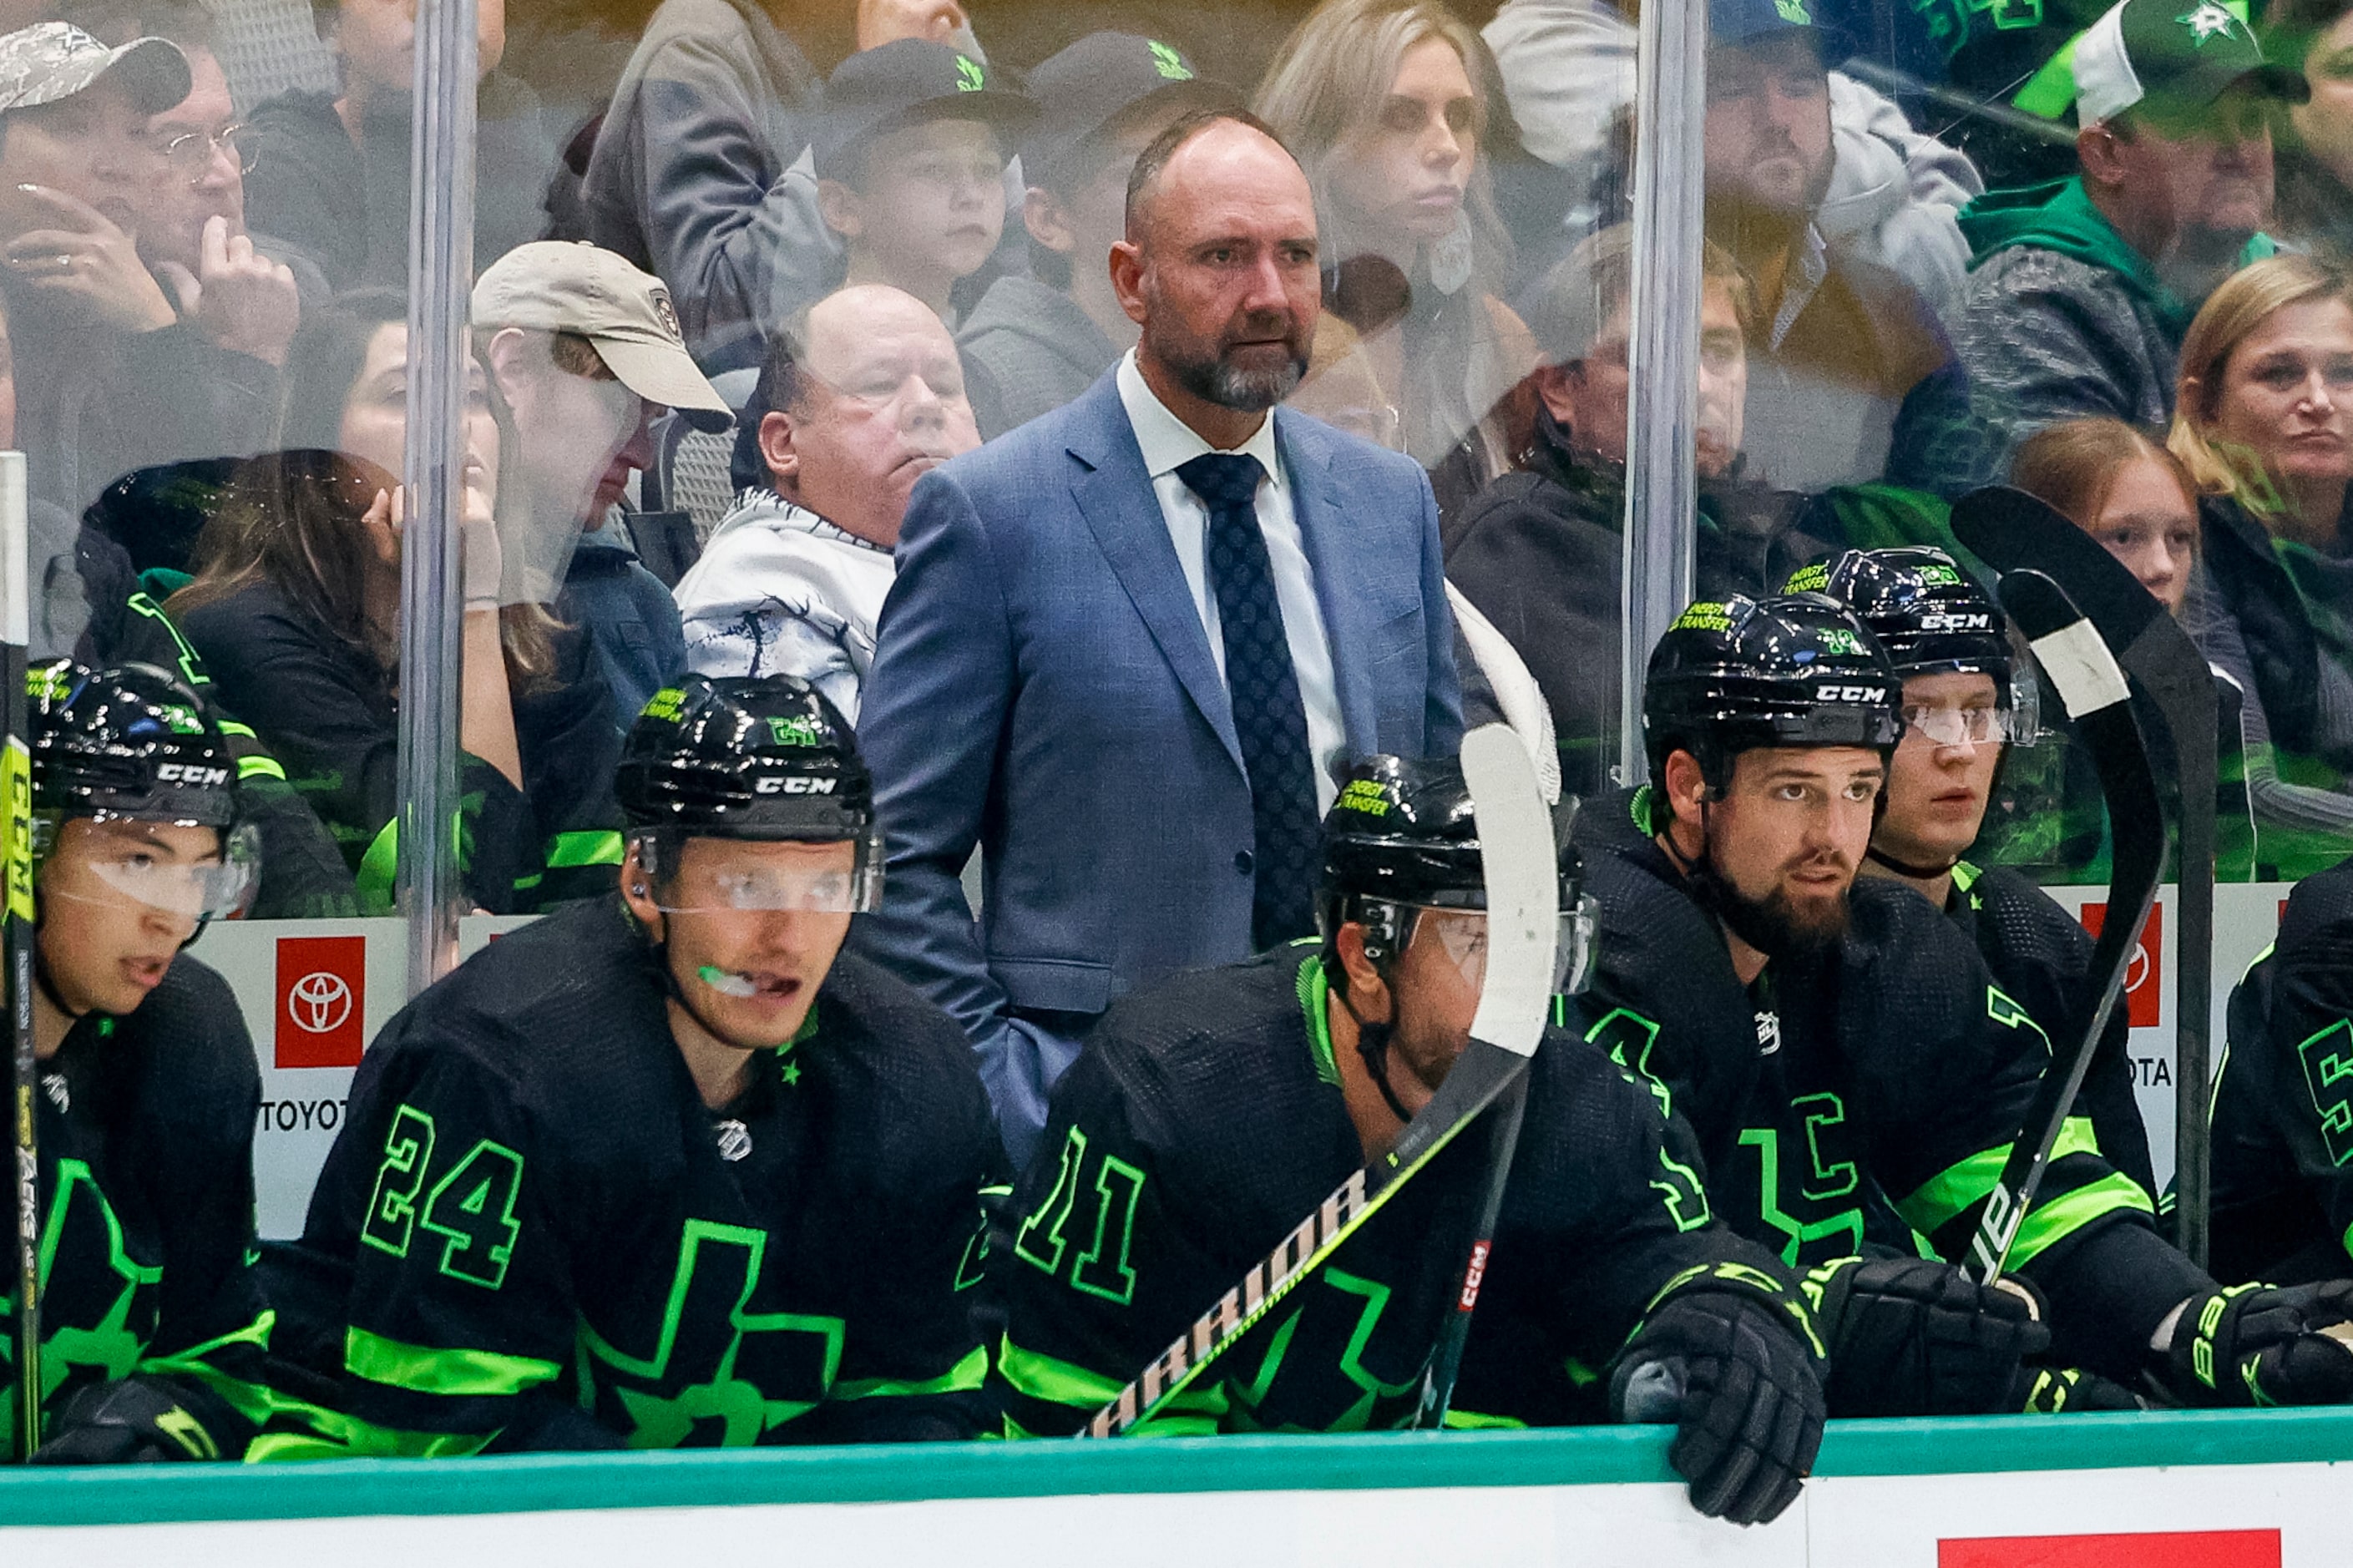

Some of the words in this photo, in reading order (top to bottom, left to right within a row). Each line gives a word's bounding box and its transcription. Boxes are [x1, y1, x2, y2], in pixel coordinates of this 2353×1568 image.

[1920, 613, 1990, 630] CCM
[1815, 685, 1886, 703] CCM
[157, 762, 230, 785] CCM
[755, 776, 837, 794] CCM
[260, 1099, 348, 1130] TOYO
[1790, 1091, 1860, 1201] C
[360, 1102, 524, 1292] 24
[1015, 1124, 1146, 1307] 11
[1461, 1245, 1488, 1308] CCM
[1074, 1168, 1369, 1438] ARRIOR
